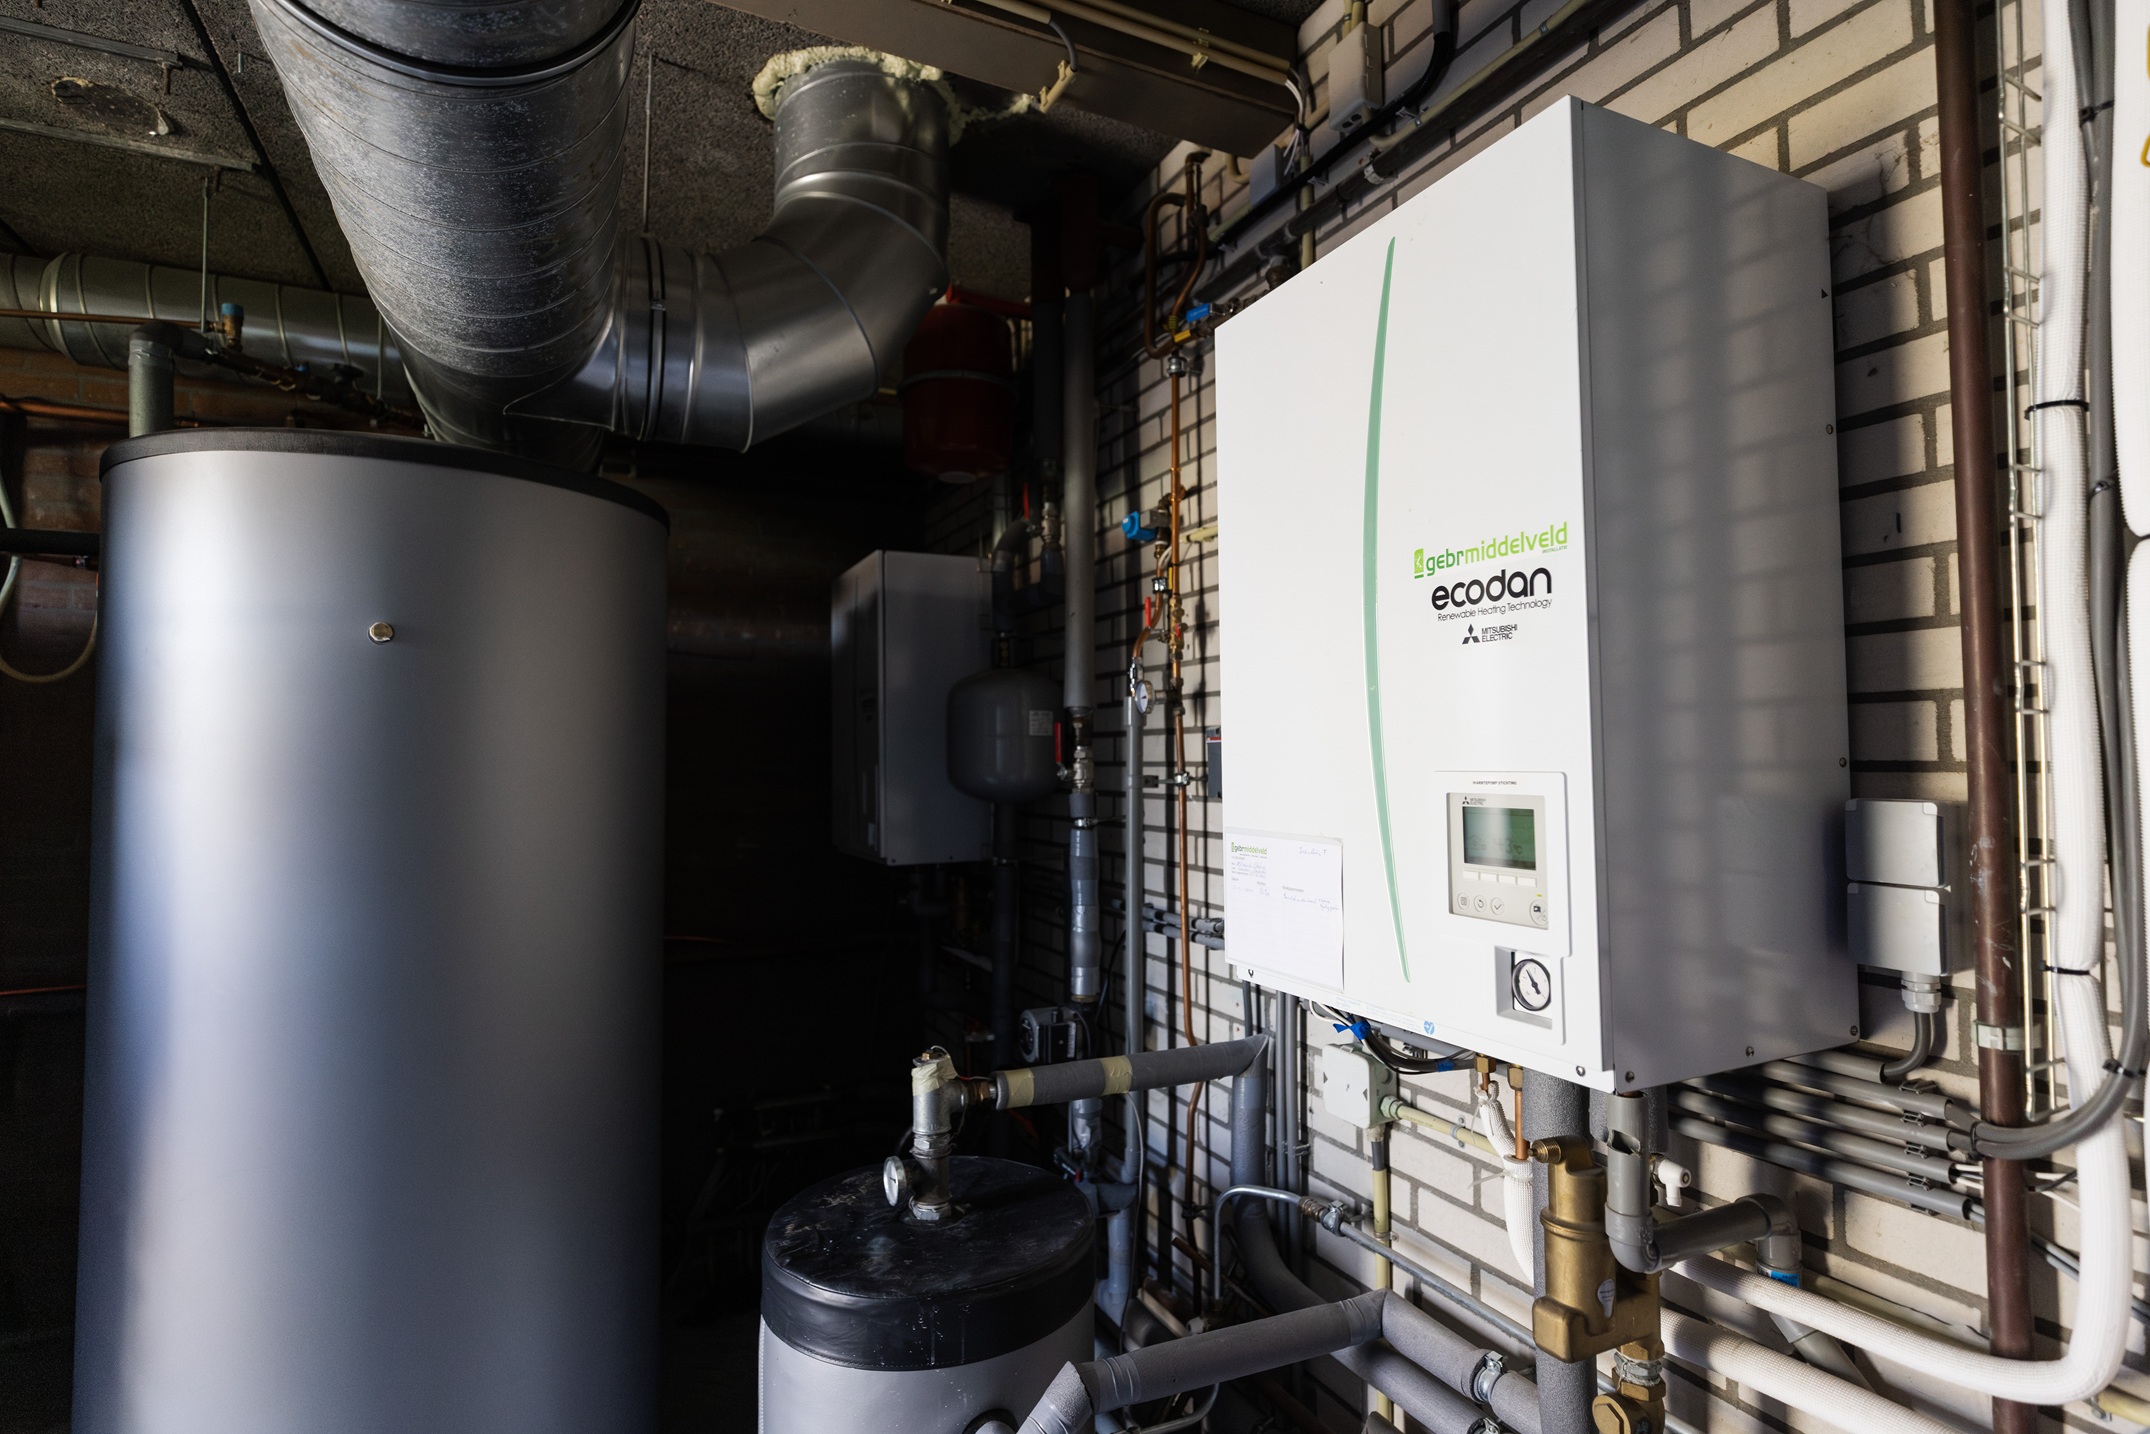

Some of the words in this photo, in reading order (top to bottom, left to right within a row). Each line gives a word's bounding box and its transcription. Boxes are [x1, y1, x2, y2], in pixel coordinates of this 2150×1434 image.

[1426, 521, 1568, 577] gebrmiddelveld
[1431, 567, 1553, 611] ecodan
[1437, 608, 1477, 622] Renewable
[1477, 603, 1506, 615] Heating
[1506, 599, 1553, 611] Technology
[1481, 623, 1518, 635] MITSUBISHI
[1481, 631, 1513, 643] ELECTRIC
